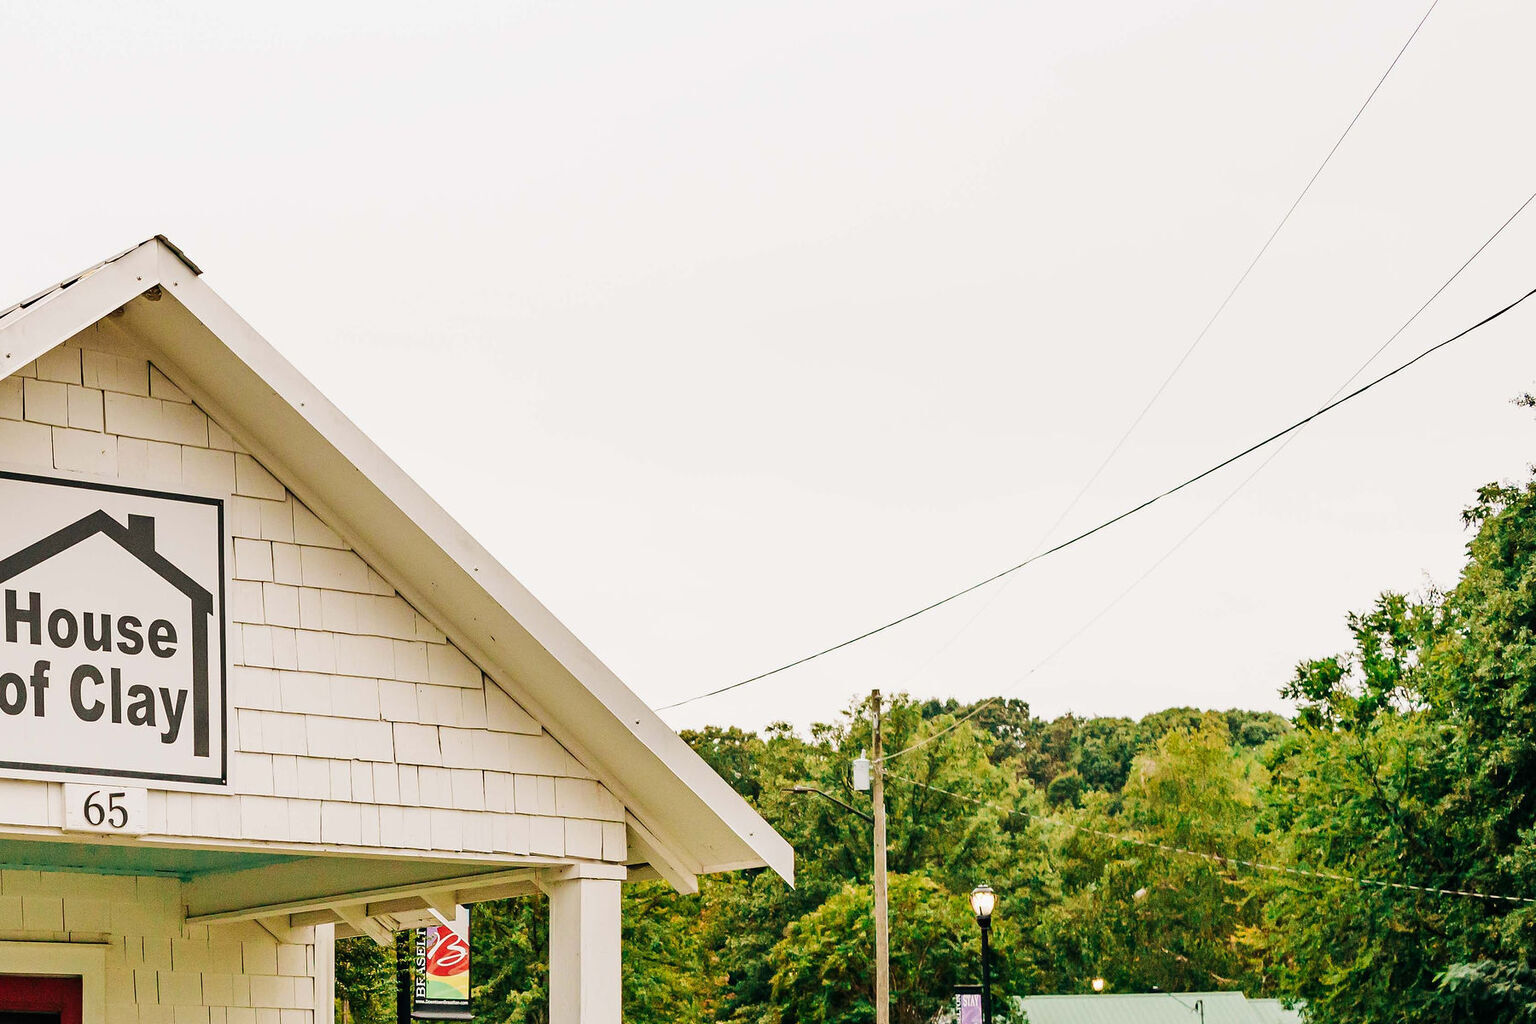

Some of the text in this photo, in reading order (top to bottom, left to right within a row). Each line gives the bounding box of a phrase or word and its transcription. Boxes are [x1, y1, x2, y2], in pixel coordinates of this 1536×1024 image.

[5, 589, 178, 658] House
[70, 664, 188, 744] Clay
[83, 790, 128, 828] 65
[963, 995, 980, 1007] STAY
